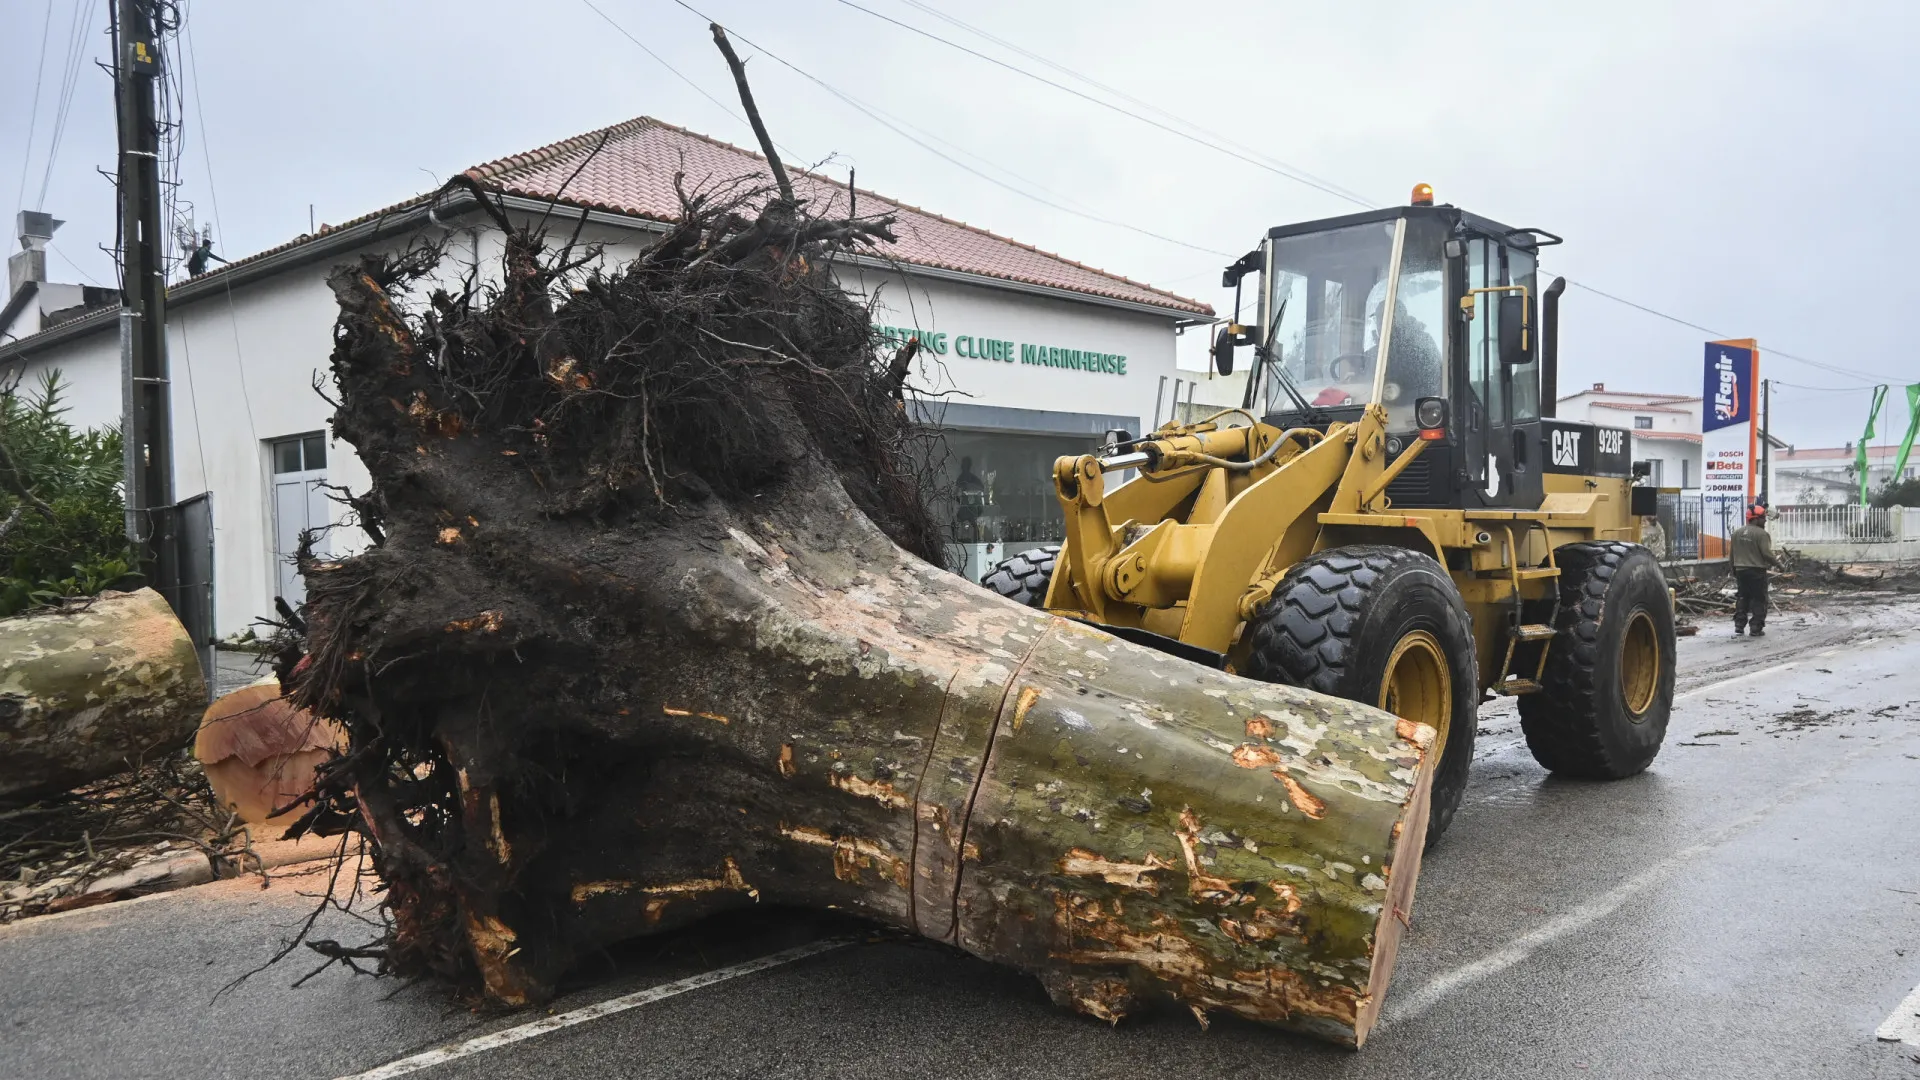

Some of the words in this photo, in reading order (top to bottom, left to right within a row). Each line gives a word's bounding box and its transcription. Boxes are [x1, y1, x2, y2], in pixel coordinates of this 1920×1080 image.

[955, 335, 1015, 362] CLUBE
[1021, 343, 1127, 375] MARINHENSE
[1552, 429, 1581, 466] CAT
[1599, 429, 1623, 454] 928F
[1716, 461, 1743, 470] Beta
